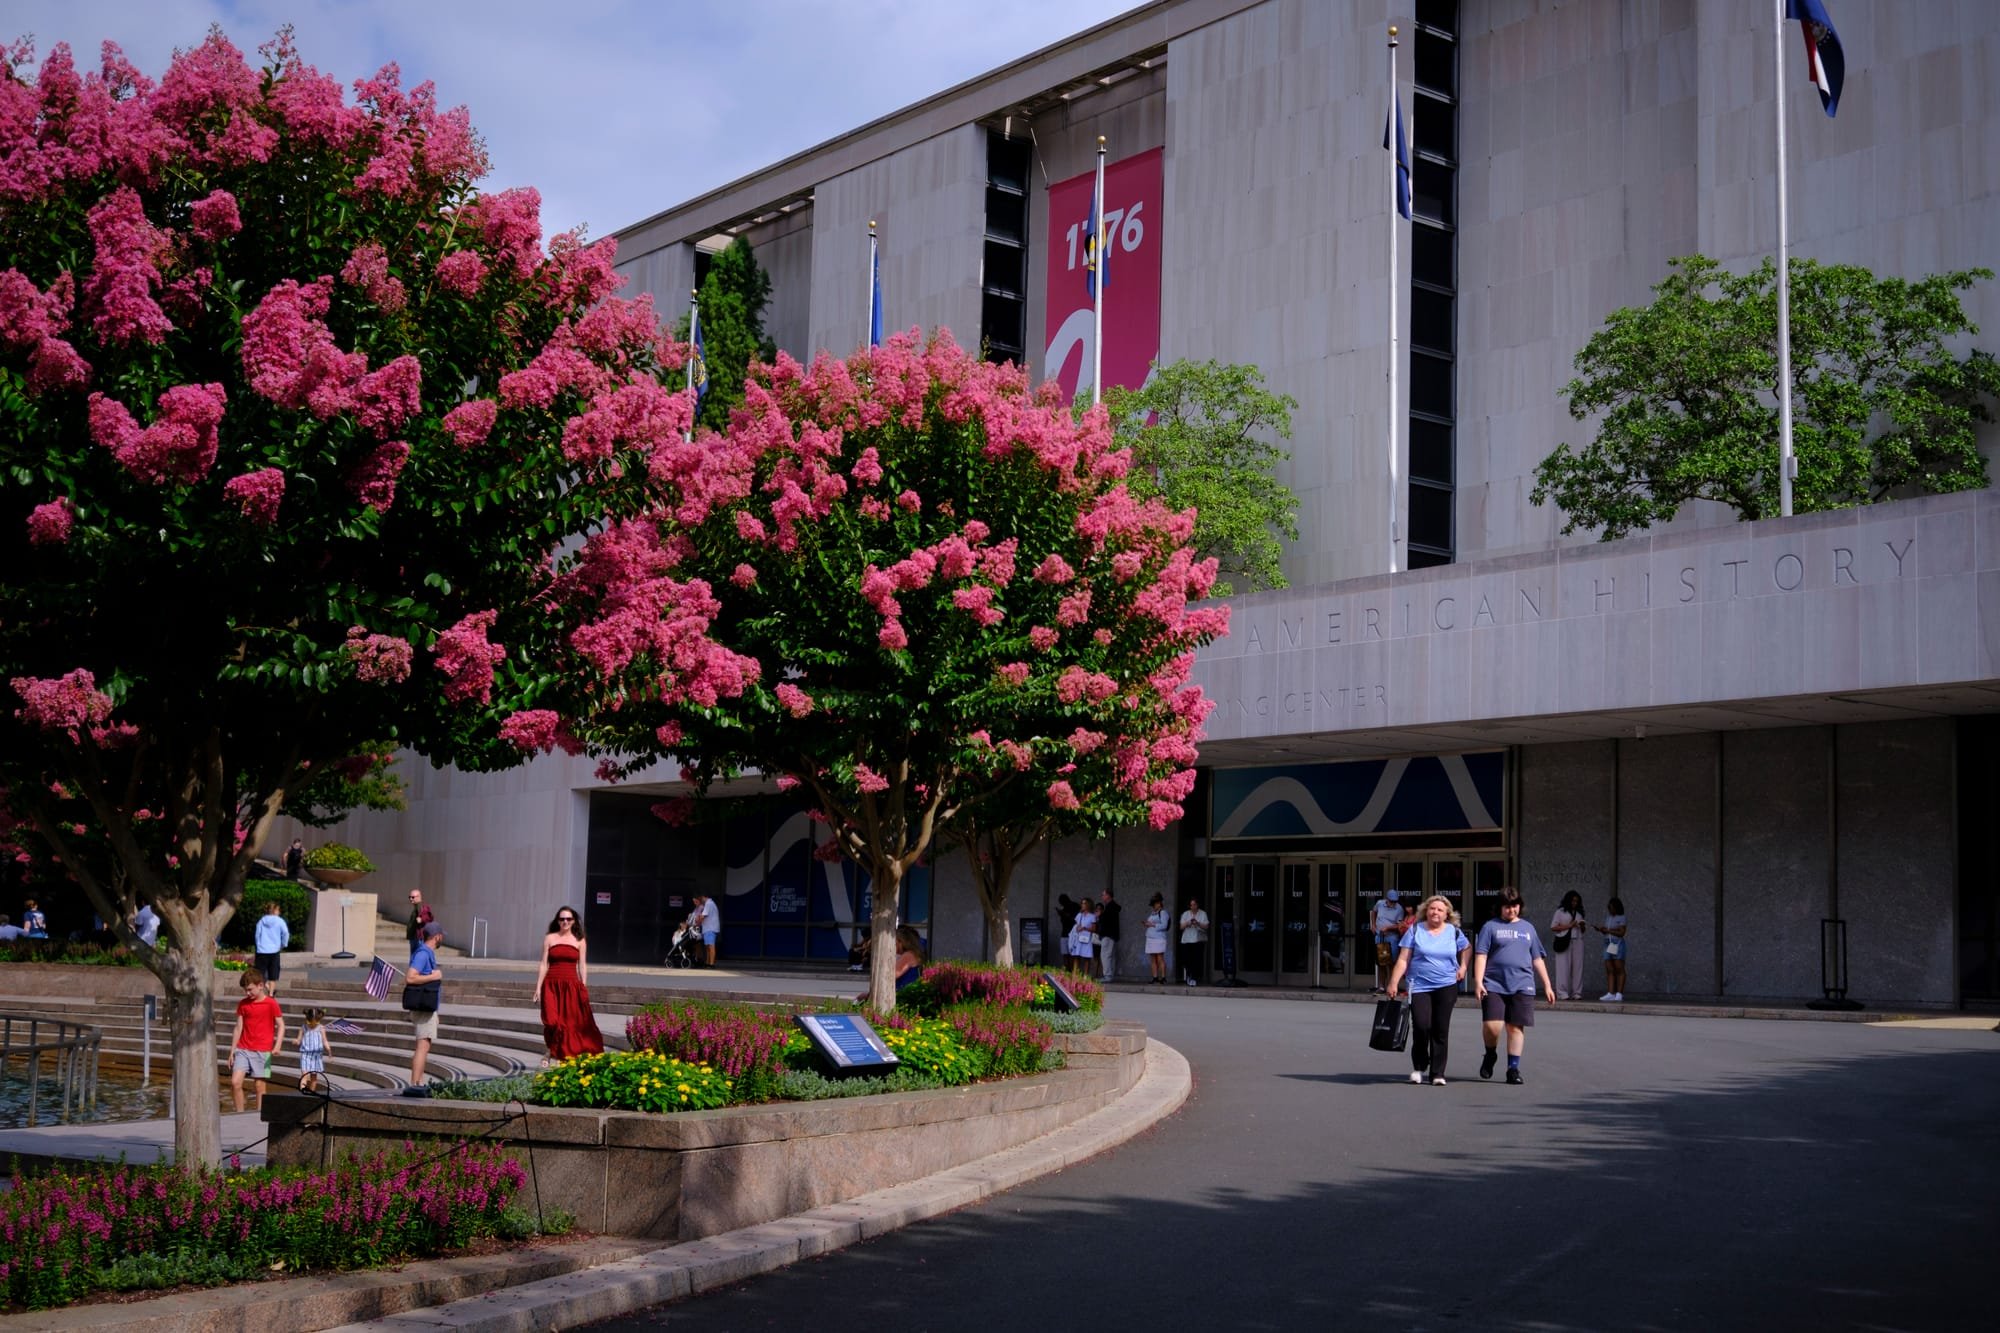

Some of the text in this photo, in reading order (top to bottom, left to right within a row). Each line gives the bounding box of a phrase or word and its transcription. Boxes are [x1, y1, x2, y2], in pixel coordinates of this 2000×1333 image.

[1246, 537, 1916, 653] AMERICAN HISTORY
[1283, 685, 1387, 714] CENTER
